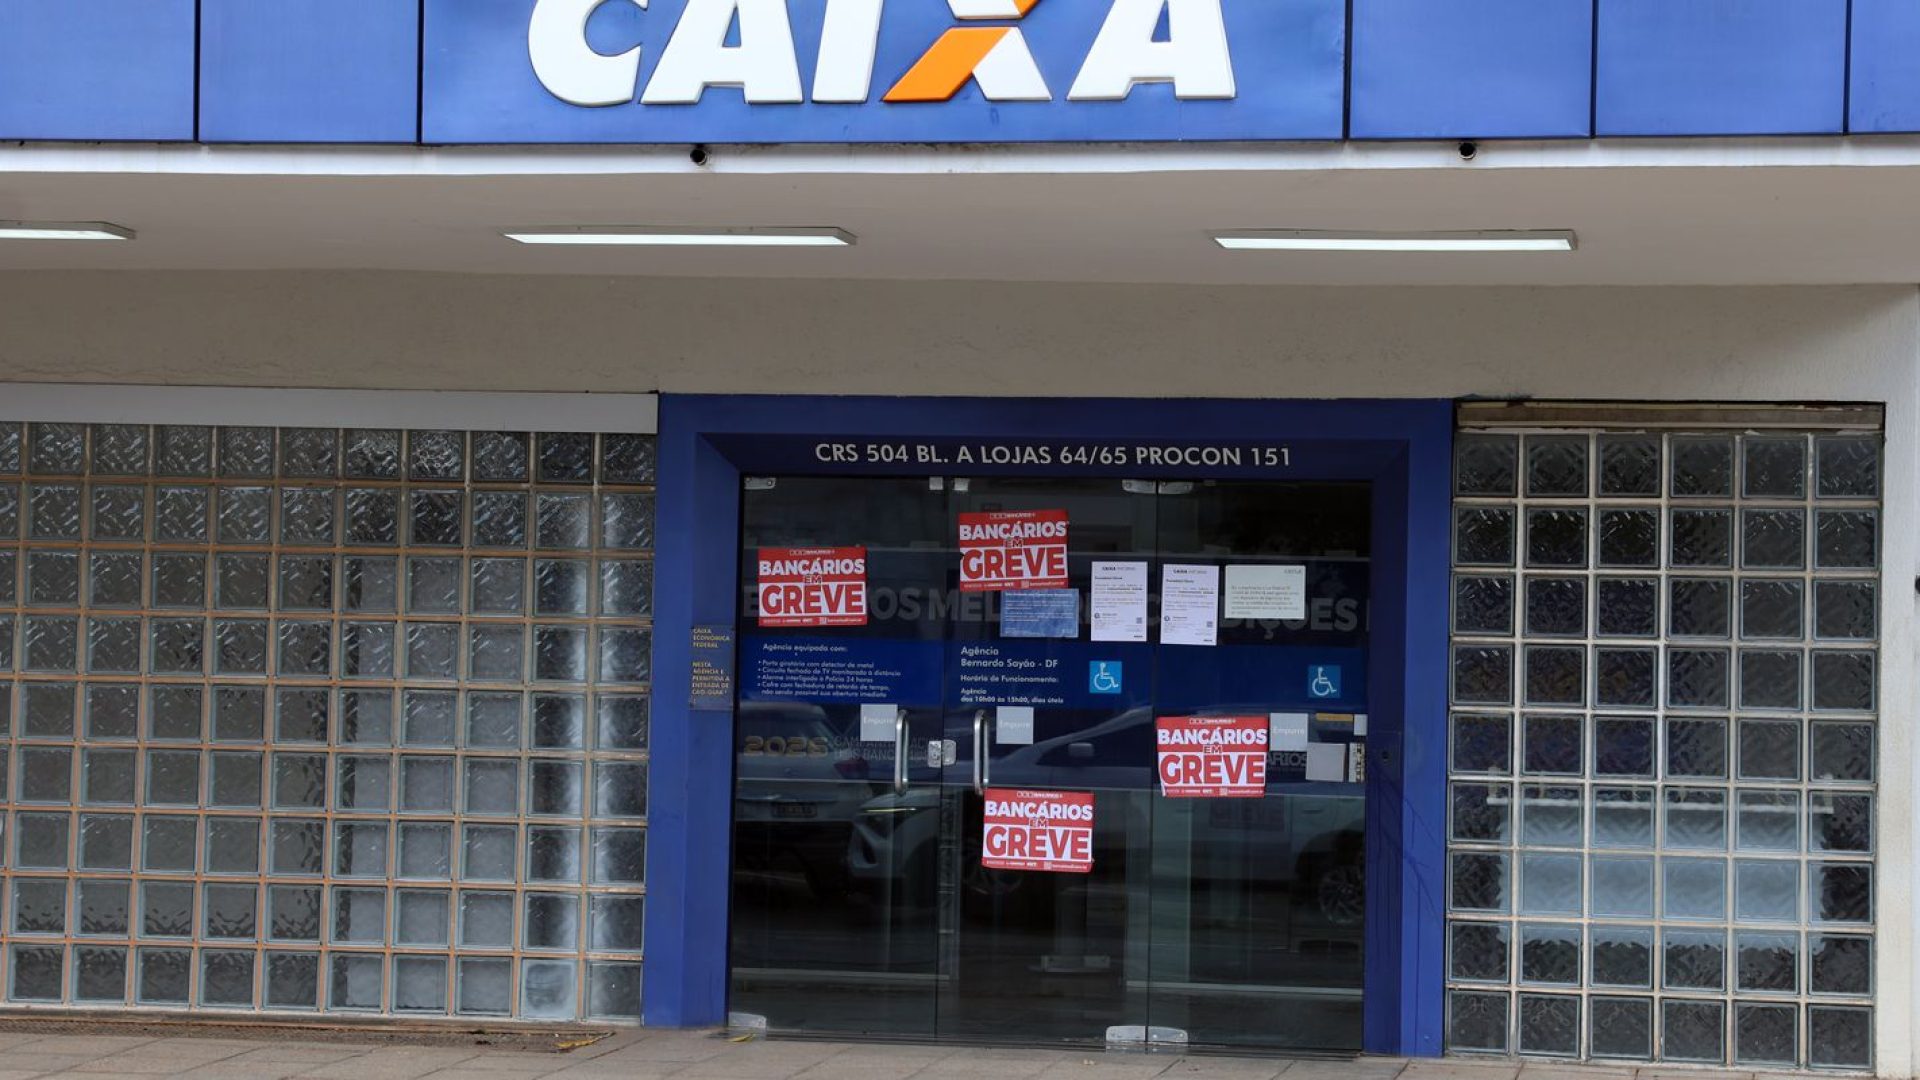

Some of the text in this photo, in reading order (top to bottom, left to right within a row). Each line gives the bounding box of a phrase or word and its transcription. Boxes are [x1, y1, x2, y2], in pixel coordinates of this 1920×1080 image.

[528, 0, 1236, 107] CAIXA
[815, 443, 1290, 467] CRS 504 BL. A LOJAS 64/65 PROCON 151
[959, 520, 1067, 541] BANCÁRIOS
[759, 557, 865, 576] BANCÁRIOS
[962, 547, 1065, 579] GREVE
[762, 585, 863, 615] GREVE
[763, 643, 792, 652] Agência
[794, 644, 828, 653] equipada
[960, 645, 999, 657] Agência
[821, 660, 845, 668] detector
[960, 658, 1004, 668] Bernardo
[1006, 657, 1036, 669] Sayão
[1045, 659, 1058, 668] DF
[960, 674, 989, 682] Horário
[1001, 674, 1060, 683] Funcionamento:
[960, 688, 987, 696] Agência
[1031, 696, 1046, 704] dias
[1157, 726, 1268, 745] BANCÁRIOS
[1160, 754, 1265, 785] GREVE
[984, 800, 1093, 821] BANCÁRIOS
[986, 826, 1089, 860] GREVE
